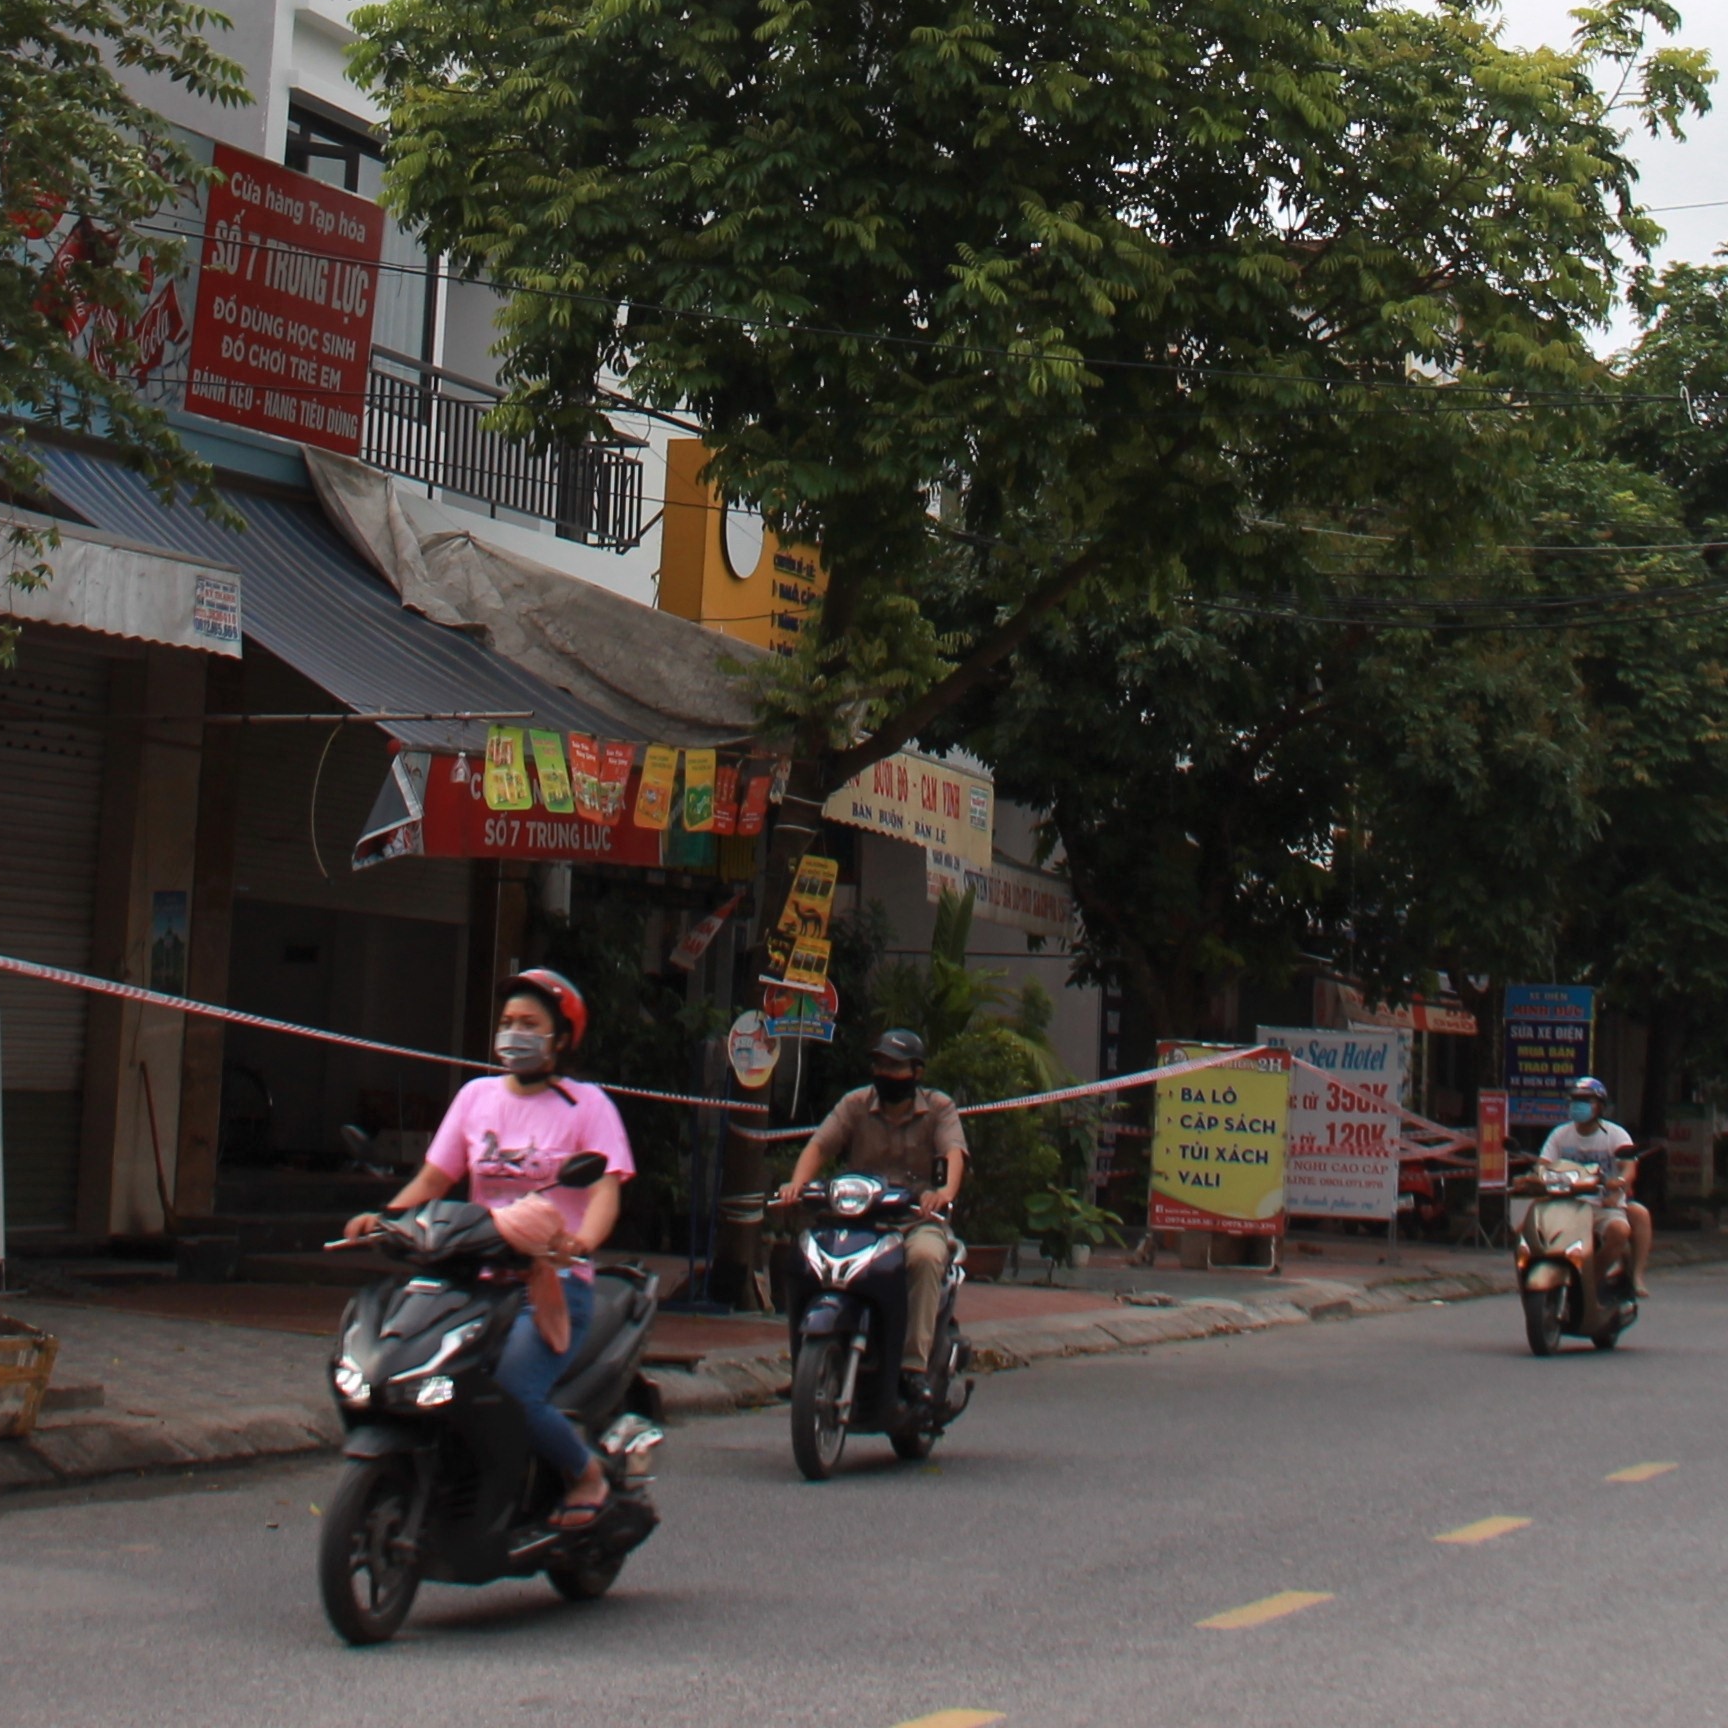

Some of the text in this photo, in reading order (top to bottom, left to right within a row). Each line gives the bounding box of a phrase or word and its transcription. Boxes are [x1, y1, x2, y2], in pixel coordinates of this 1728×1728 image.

[230, 171, 366, 244] Cửa hàng Tạp hóa
[213, 210, 370, 325] SỐ 7 TRUNG LỰC
[240, 308, 284, 341] DÙNG
[287, 322, 319, 356] HỌC
[321, 335, 357, 363] SINH
[289, 357, 317, 386] TRẺ
[320, 367, 342, 393] EM
[921, 773, 937, 813] CAM
[943, 781, 961, 820] VINH
[484, 811, 508, 847] SỐ
[509, 820, 521, 849] 7
[525, 821, 581, 851] TRUNG
[879, 808, 903, 830] BUÔN
[1537, 1026, 1552, 1040] XE
[1309, 1039, 1338, 1070] Sea
[1341, 1040, 1389, 1072] Hotel
[1181, 1085, 1238, 1105] BA LÔ
[1179, 1111, 1276, 1135] CẶP SÁCH
[1214, 1144, 1269, 1165] XÁCH
[1331, 1162, 1360, 1175] CAO
[1178, 1170, 1221, 1188] VALI
